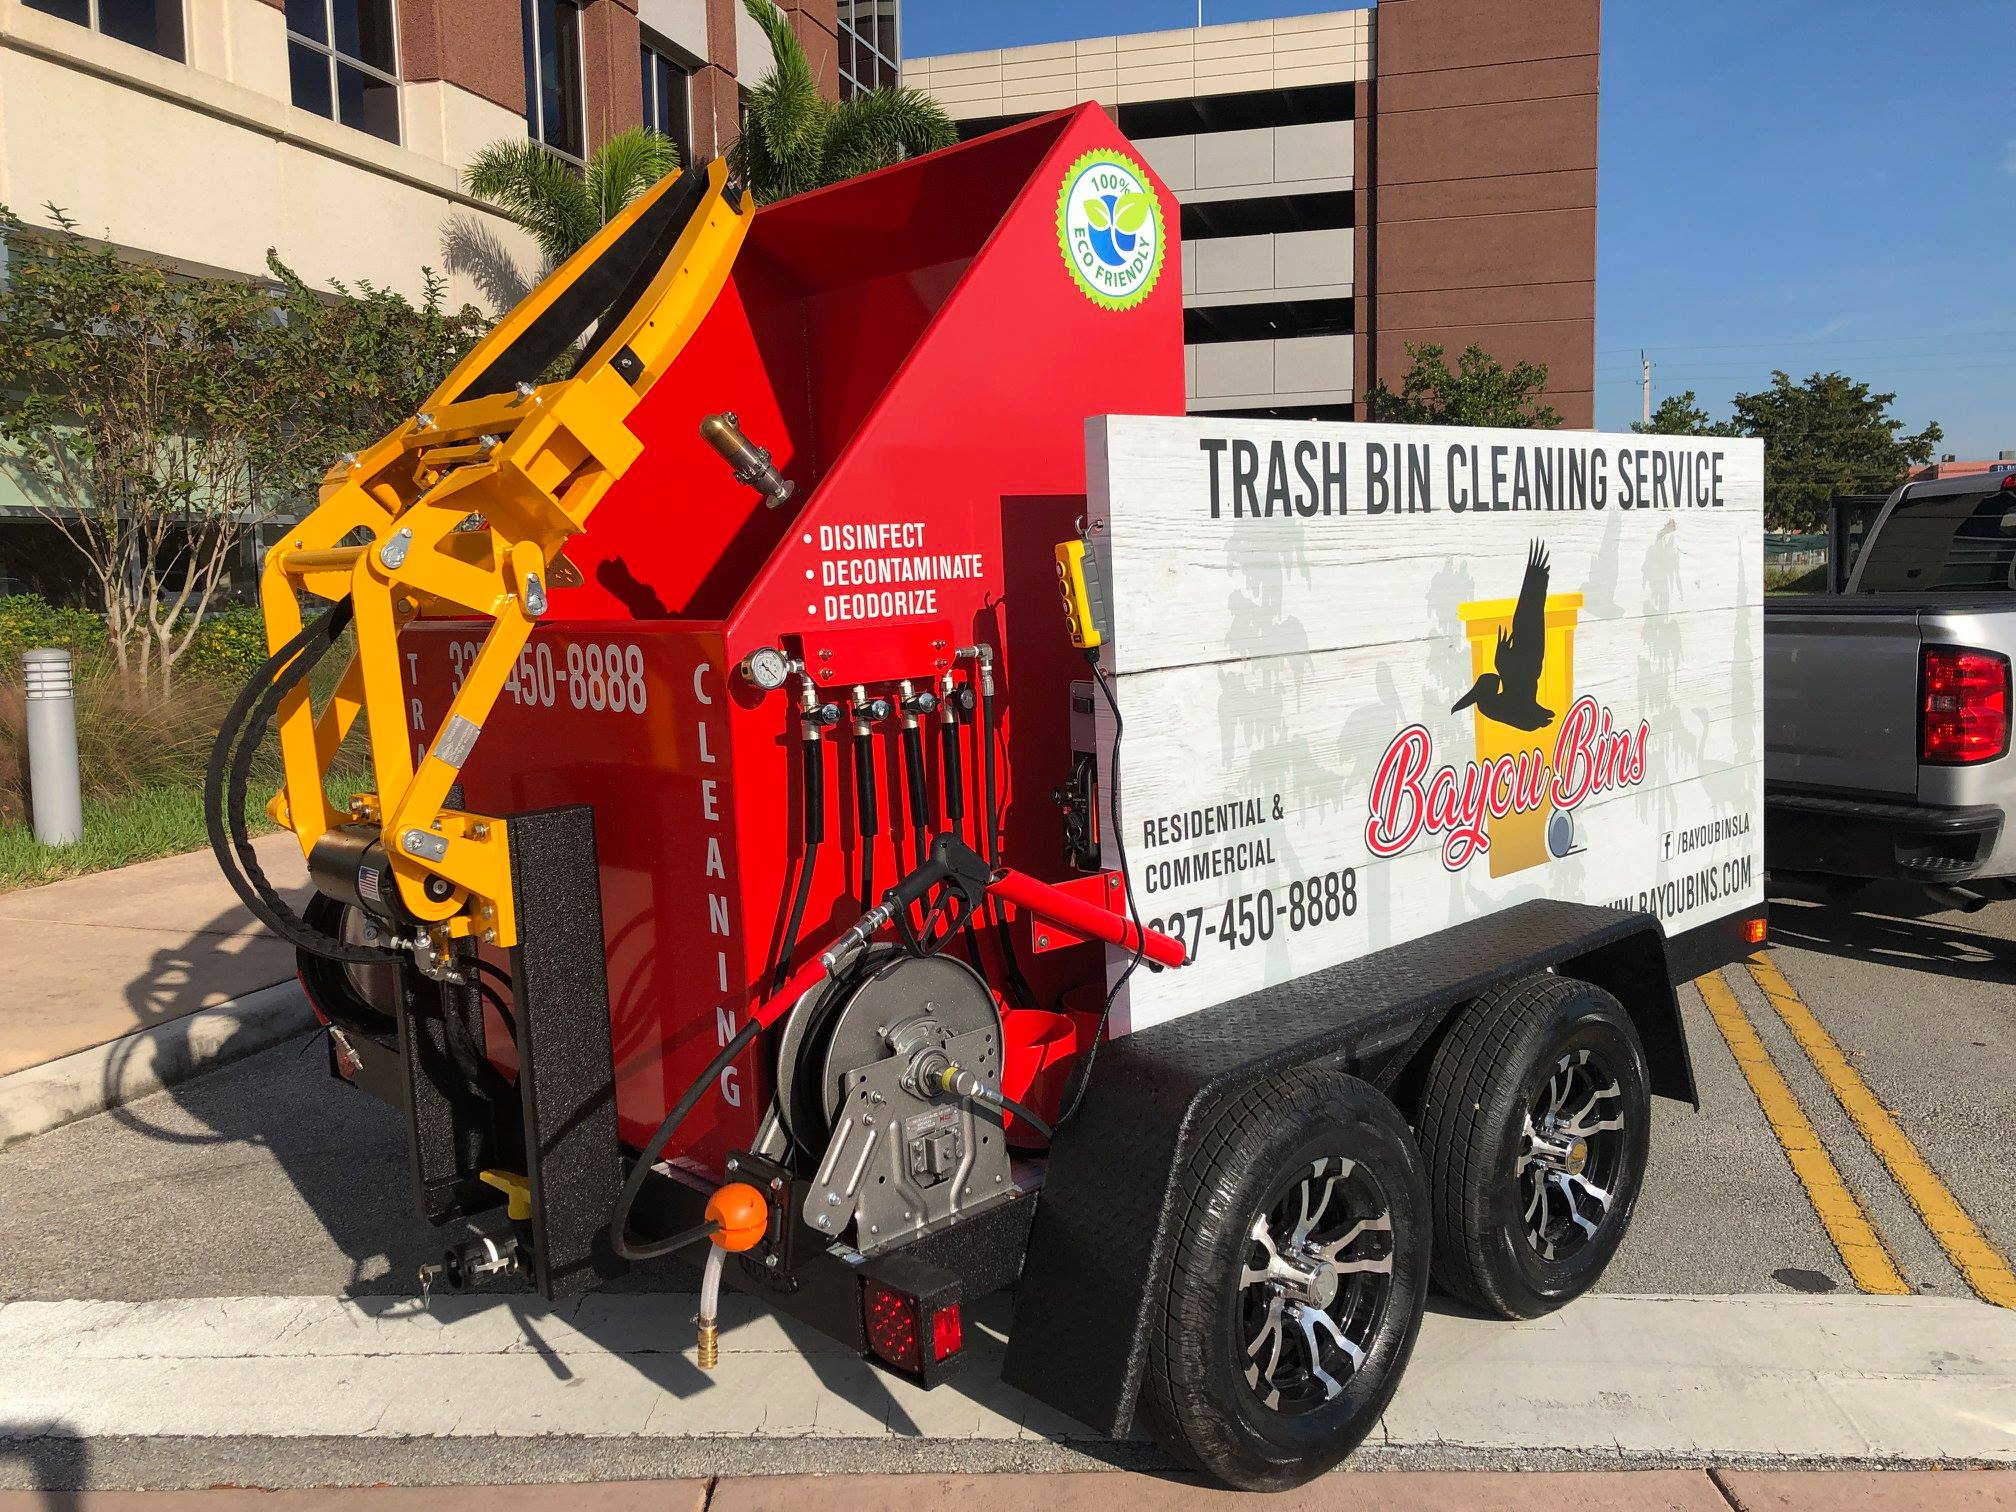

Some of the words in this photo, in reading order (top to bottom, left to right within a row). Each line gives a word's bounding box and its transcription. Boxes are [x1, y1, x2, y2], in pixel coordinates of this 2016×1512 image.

[1091, 173, 1131, 195] 100%
[1074, 227, 1094, 267] ECO
[1095, 236, 1150, 288] FRIENDLY
[1199, 438, 1348, 518] TRASH
[1366, 442, 1431, 515] BIN
[1447, 443, 1607, 513] CLEANING
[1618, 448, 1724, 510] SERVICE
[819, 522, 925, 551] DISINFECT
[822, 554, 983, 586] DECONTAMINATE
[824, 589, 937, 622] DEODORIZE
[449, 641, 647, 714] 3450-8888
[1365, 723, 1550, 872] Bayou
[1550, 694, 1650, 811] Bins
[1143, 797, 1266, 849] RESIDENTIAL
[1272, 793, 1284, 820] &
[1677, 812, 1750, 855] /BAYOUBINSLA
[693, 663, 741, 1107] CLEANING
[1145, 837, 1276, 893] COMMERCIAL
[1602, 854, 1751, 921] BAYOUBINS.COM
